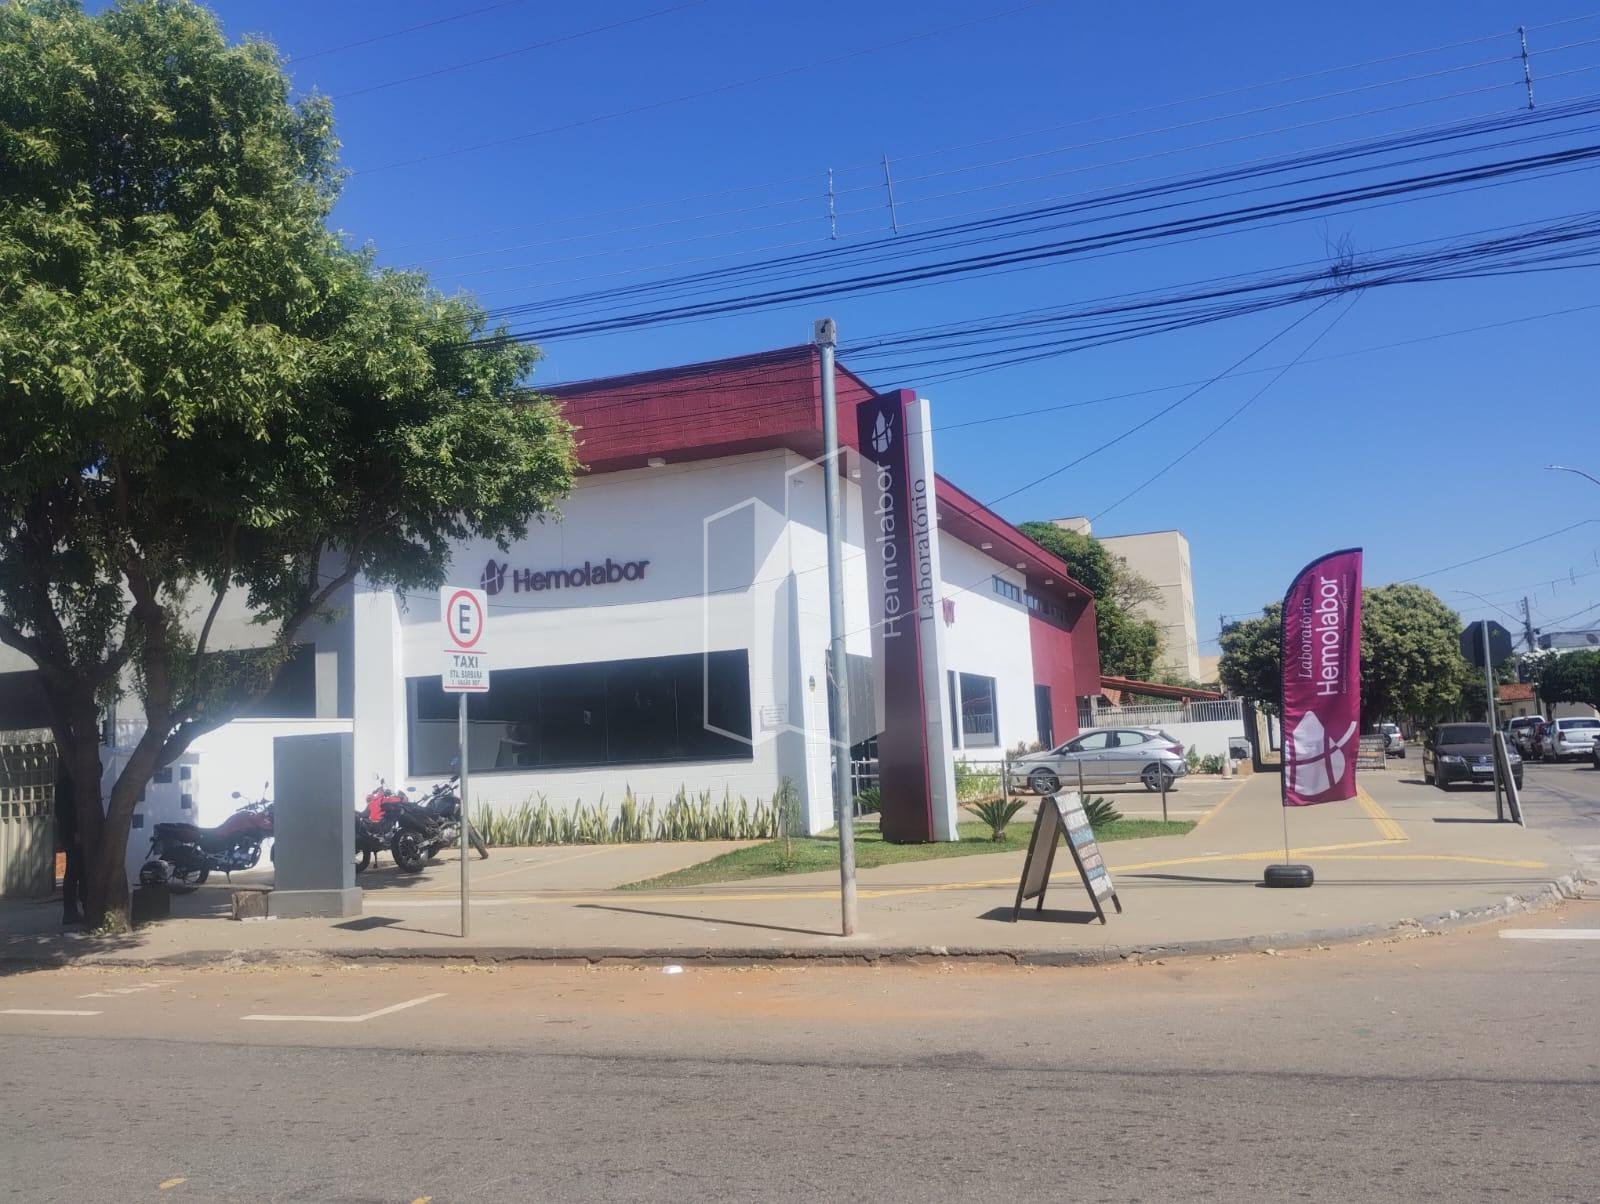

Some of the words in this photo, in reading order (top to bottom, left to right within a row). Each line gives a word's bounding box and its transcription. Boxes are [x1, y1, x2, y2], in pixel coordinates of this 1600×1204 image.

[512, 558, 650, 593] Hemolabor
[874, 460, 902, 638] Hemolabor
[911, 479, 934, 623] Laboratório
[459, 604, 471, 634] E
[1298, 597, 1313, 679] Laboratório
[1315, 576, 1339, 696] Hemolabor
[453, 655, 479, 669] TAXI
